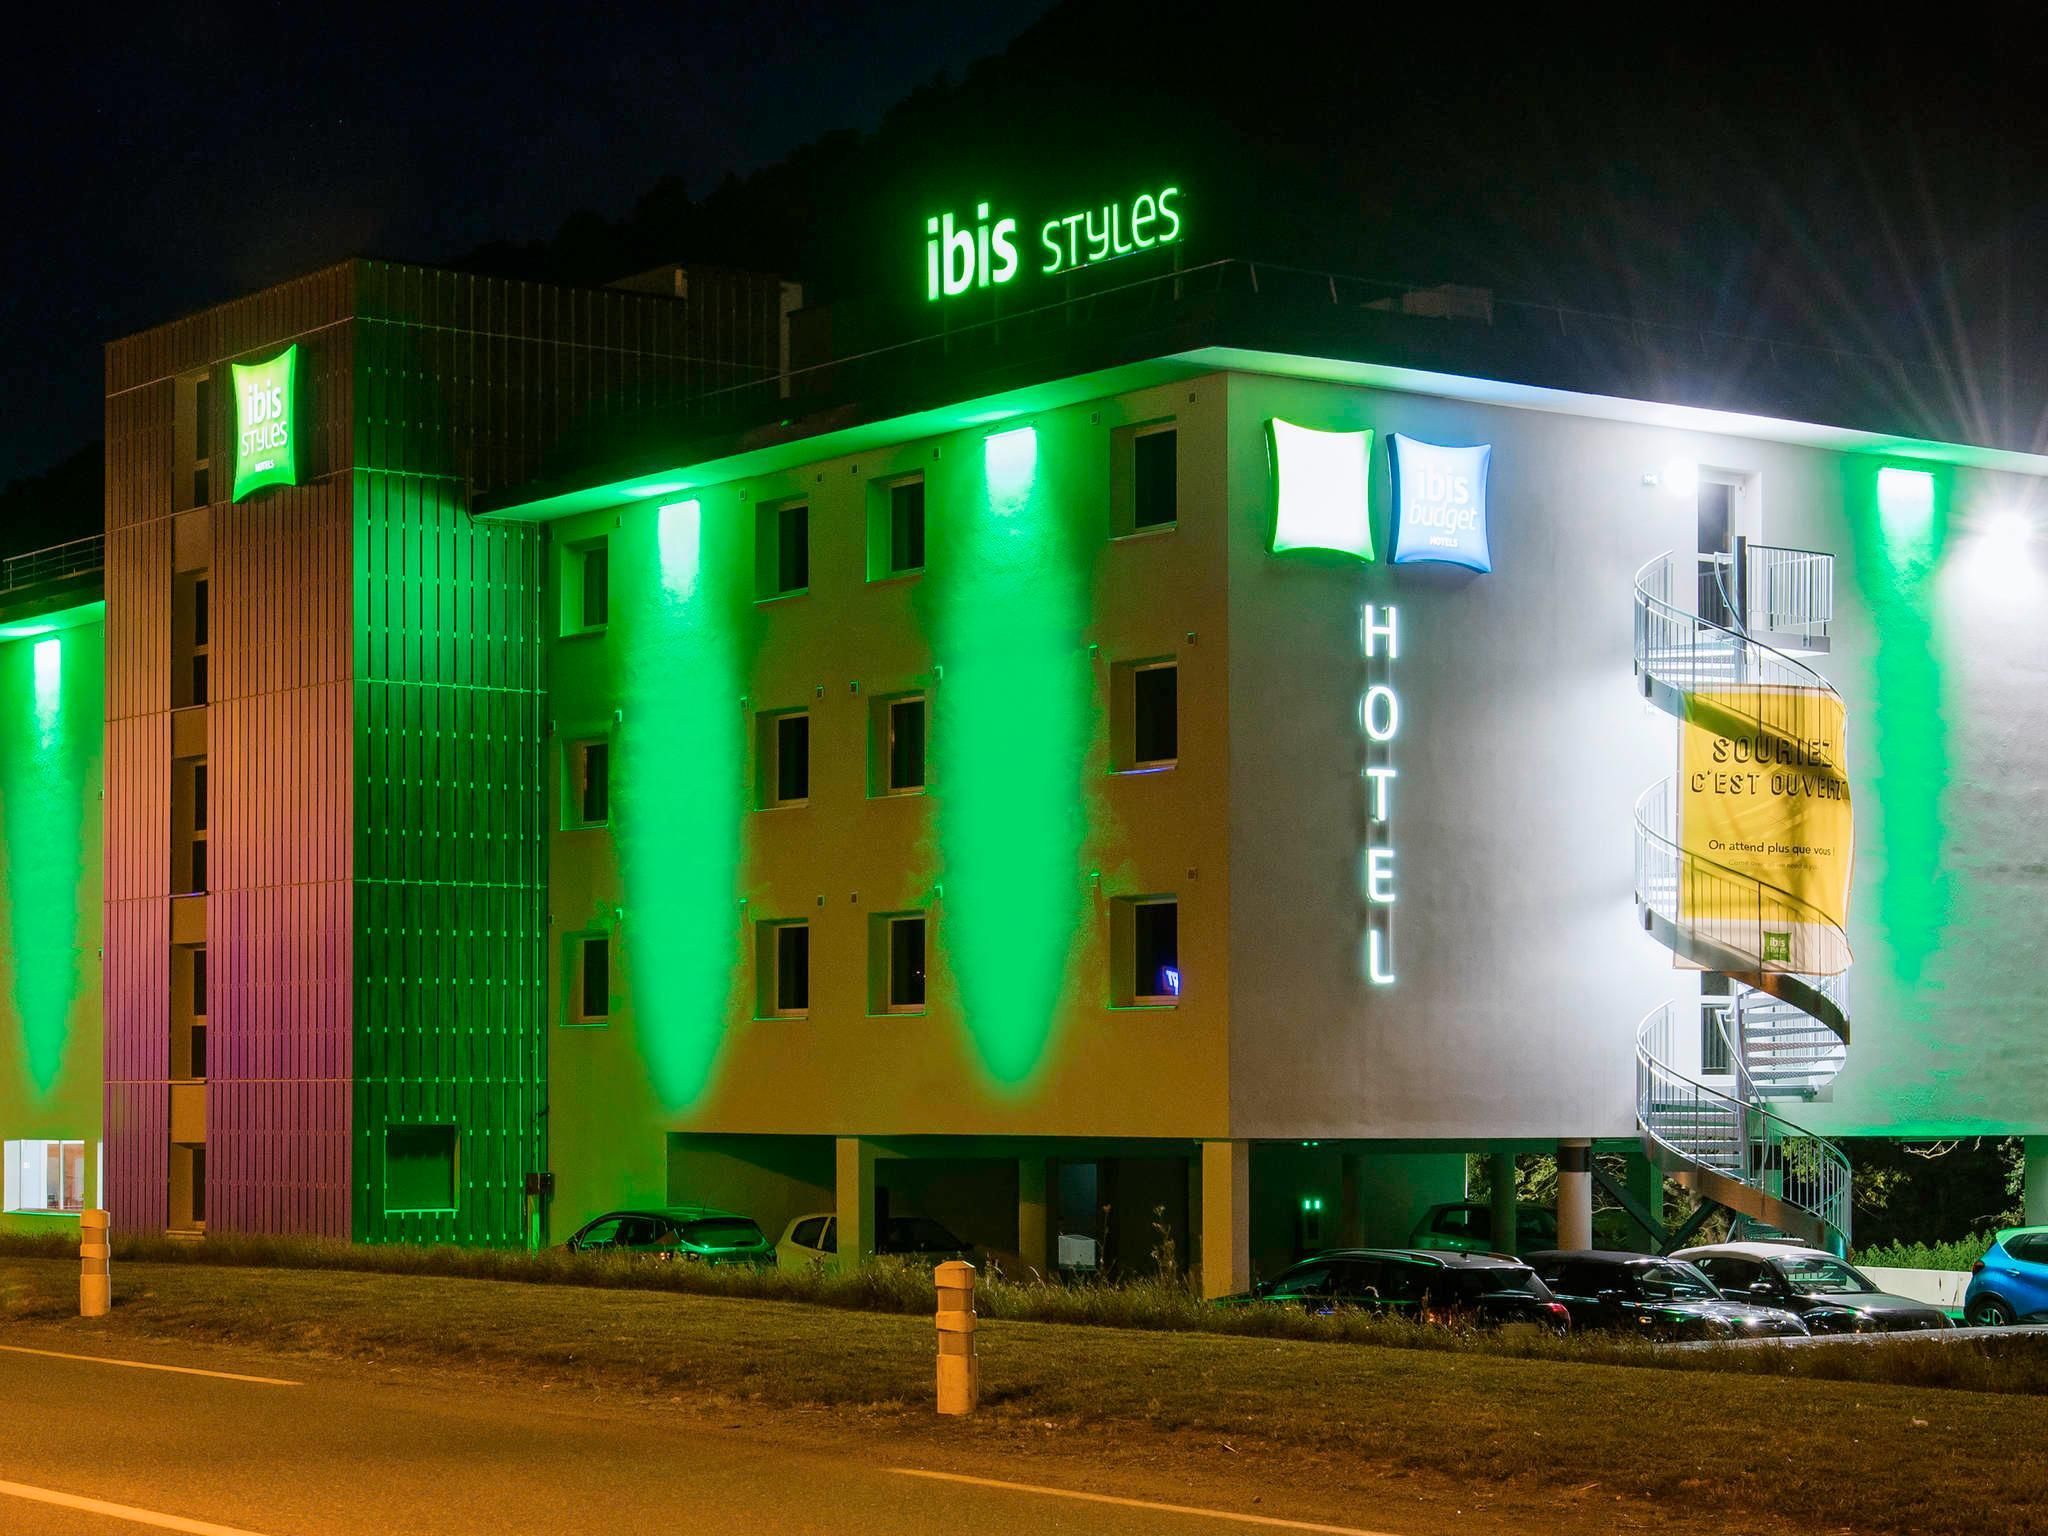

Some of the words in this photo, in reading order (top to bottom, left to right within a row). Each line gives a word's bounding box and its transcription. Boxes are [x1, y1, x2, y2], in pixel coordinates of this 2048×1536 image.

[927, 202, 1018, 301] ibis
[248, 379, 282, 425] ibis
[1416, 464, 1470, 505] ibis
[1408, 499, 1478, 534] budget
[1360, 604, 1399, 985] HOTEL
[1691, 770, 1761, 795] C'EST
[1708, 840, 1726, 850] On
[1729, 842, 1764, 853] attend
[1768, 842, 1789, 855] plus
[1792, 845, 1811, 856] que
